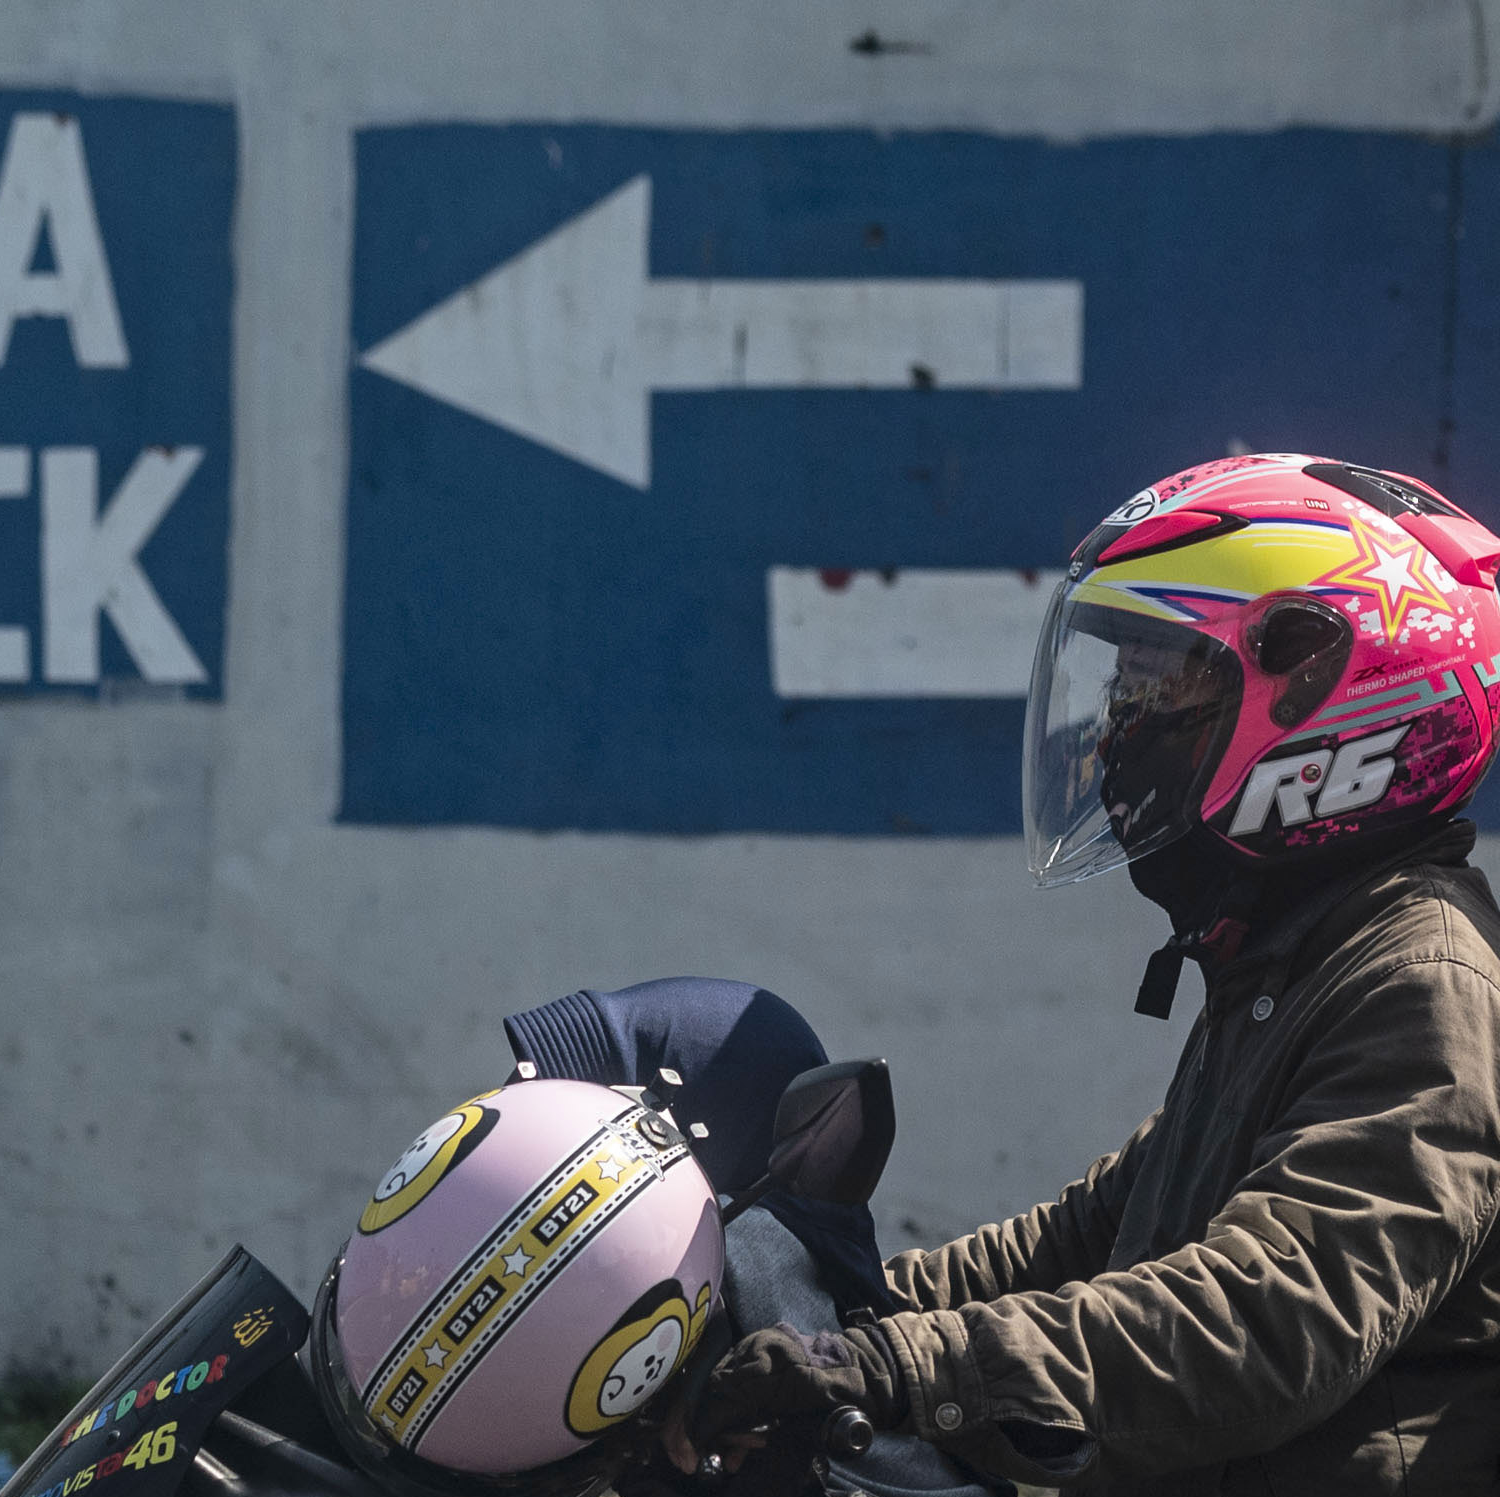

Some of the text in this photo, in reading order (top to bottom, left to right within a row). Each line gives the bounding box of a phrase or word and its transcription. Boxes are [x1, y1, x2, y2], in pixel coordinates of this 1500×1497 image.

[1305, 499, 1329, 511] UNI
[1347, 678, 1387, 697] THERMO
[1388, 666, 1426, 685] SHAPED
[1228, 723, 1413, 837] R6
[538, 1187, 593, 1240] BT21
[448, 1284, 500, 1337] BT21
[115, 1354, 228, 1421] DOCTOR
[390, 1376, 423, 1413] BT21
[123, 1421, 177, 1470] 46
